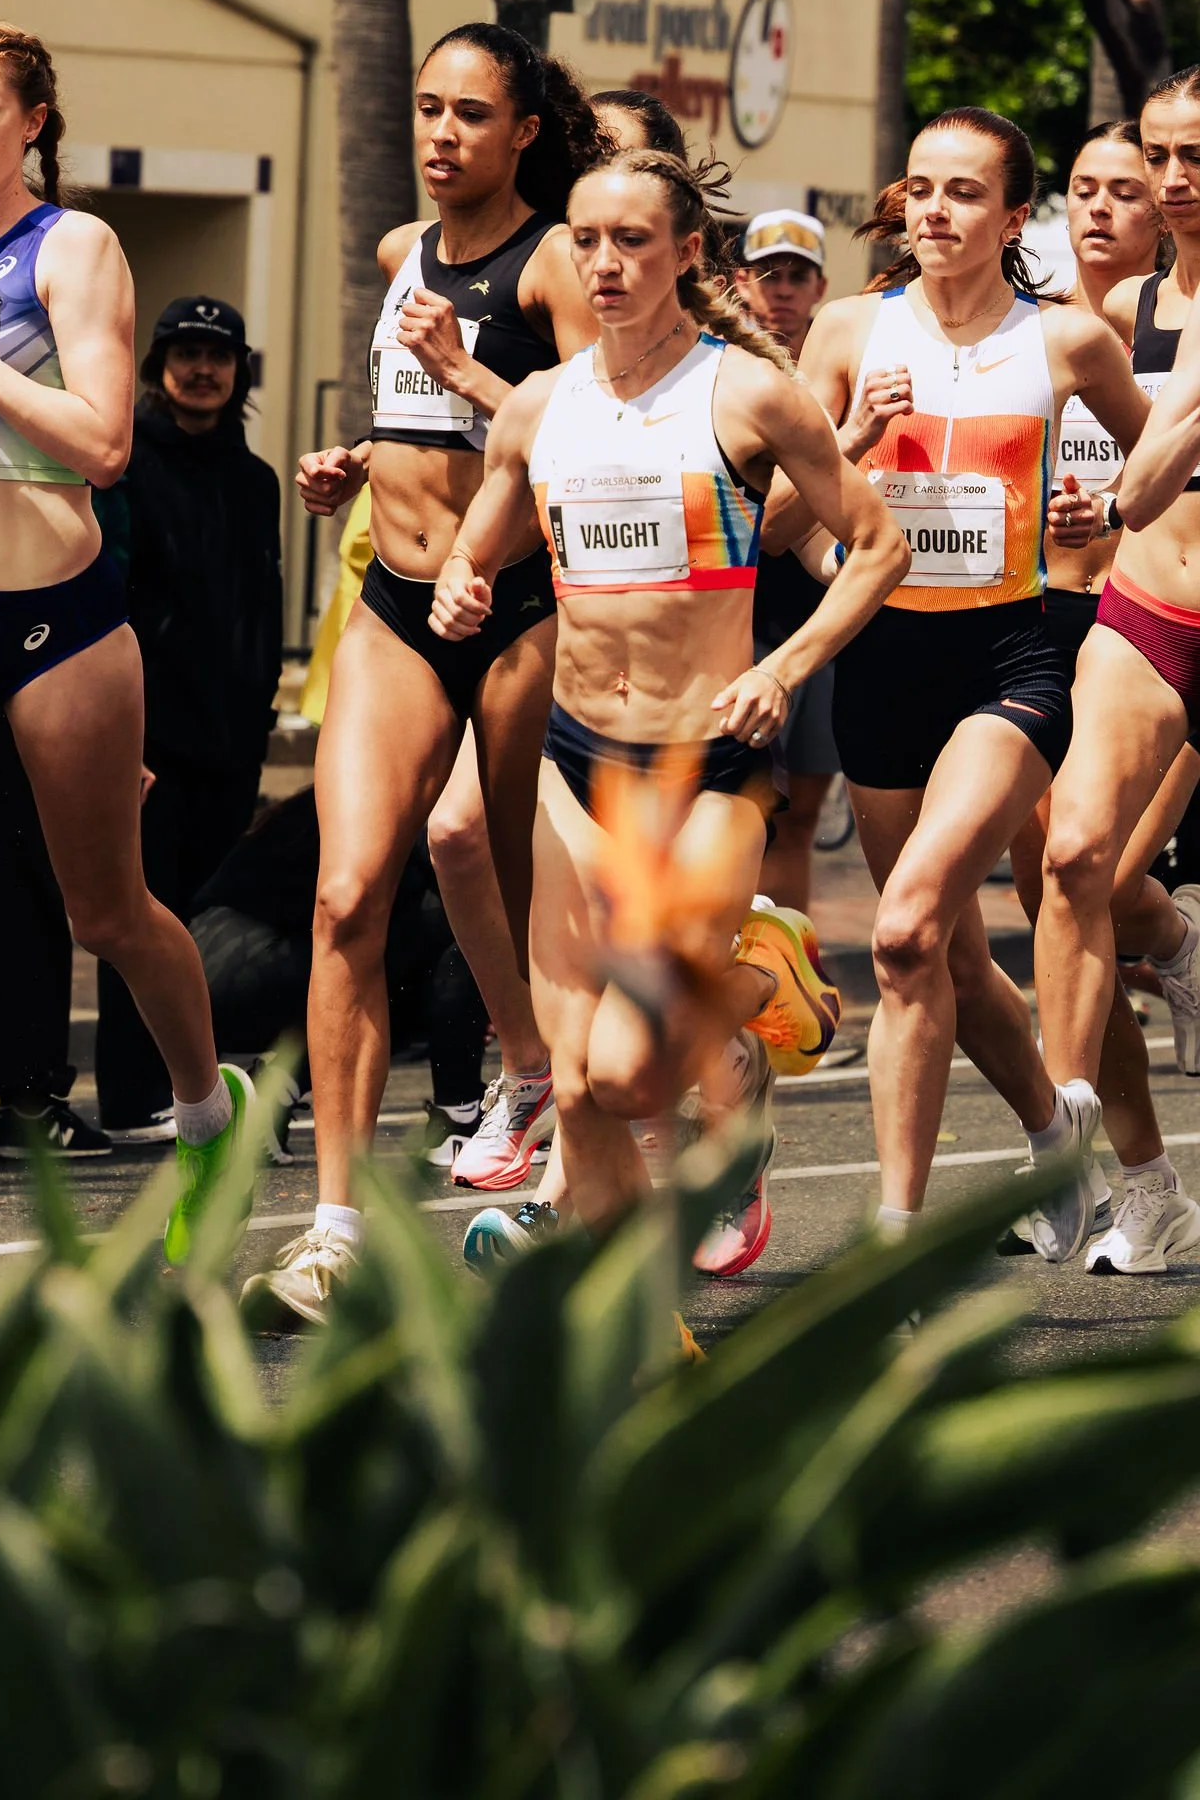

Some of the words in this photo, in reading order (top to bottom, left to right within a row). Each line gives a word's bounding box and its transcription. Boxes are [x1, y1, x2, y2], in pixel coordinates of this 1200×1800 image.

[591, 475, 662, 487] CARLSBAD5000
[913, 485, 987, 494] CARLSBAD5000
[580, 521, 660, 550] VAUGHT
[901, 528, 988, 554] LOUDRE
